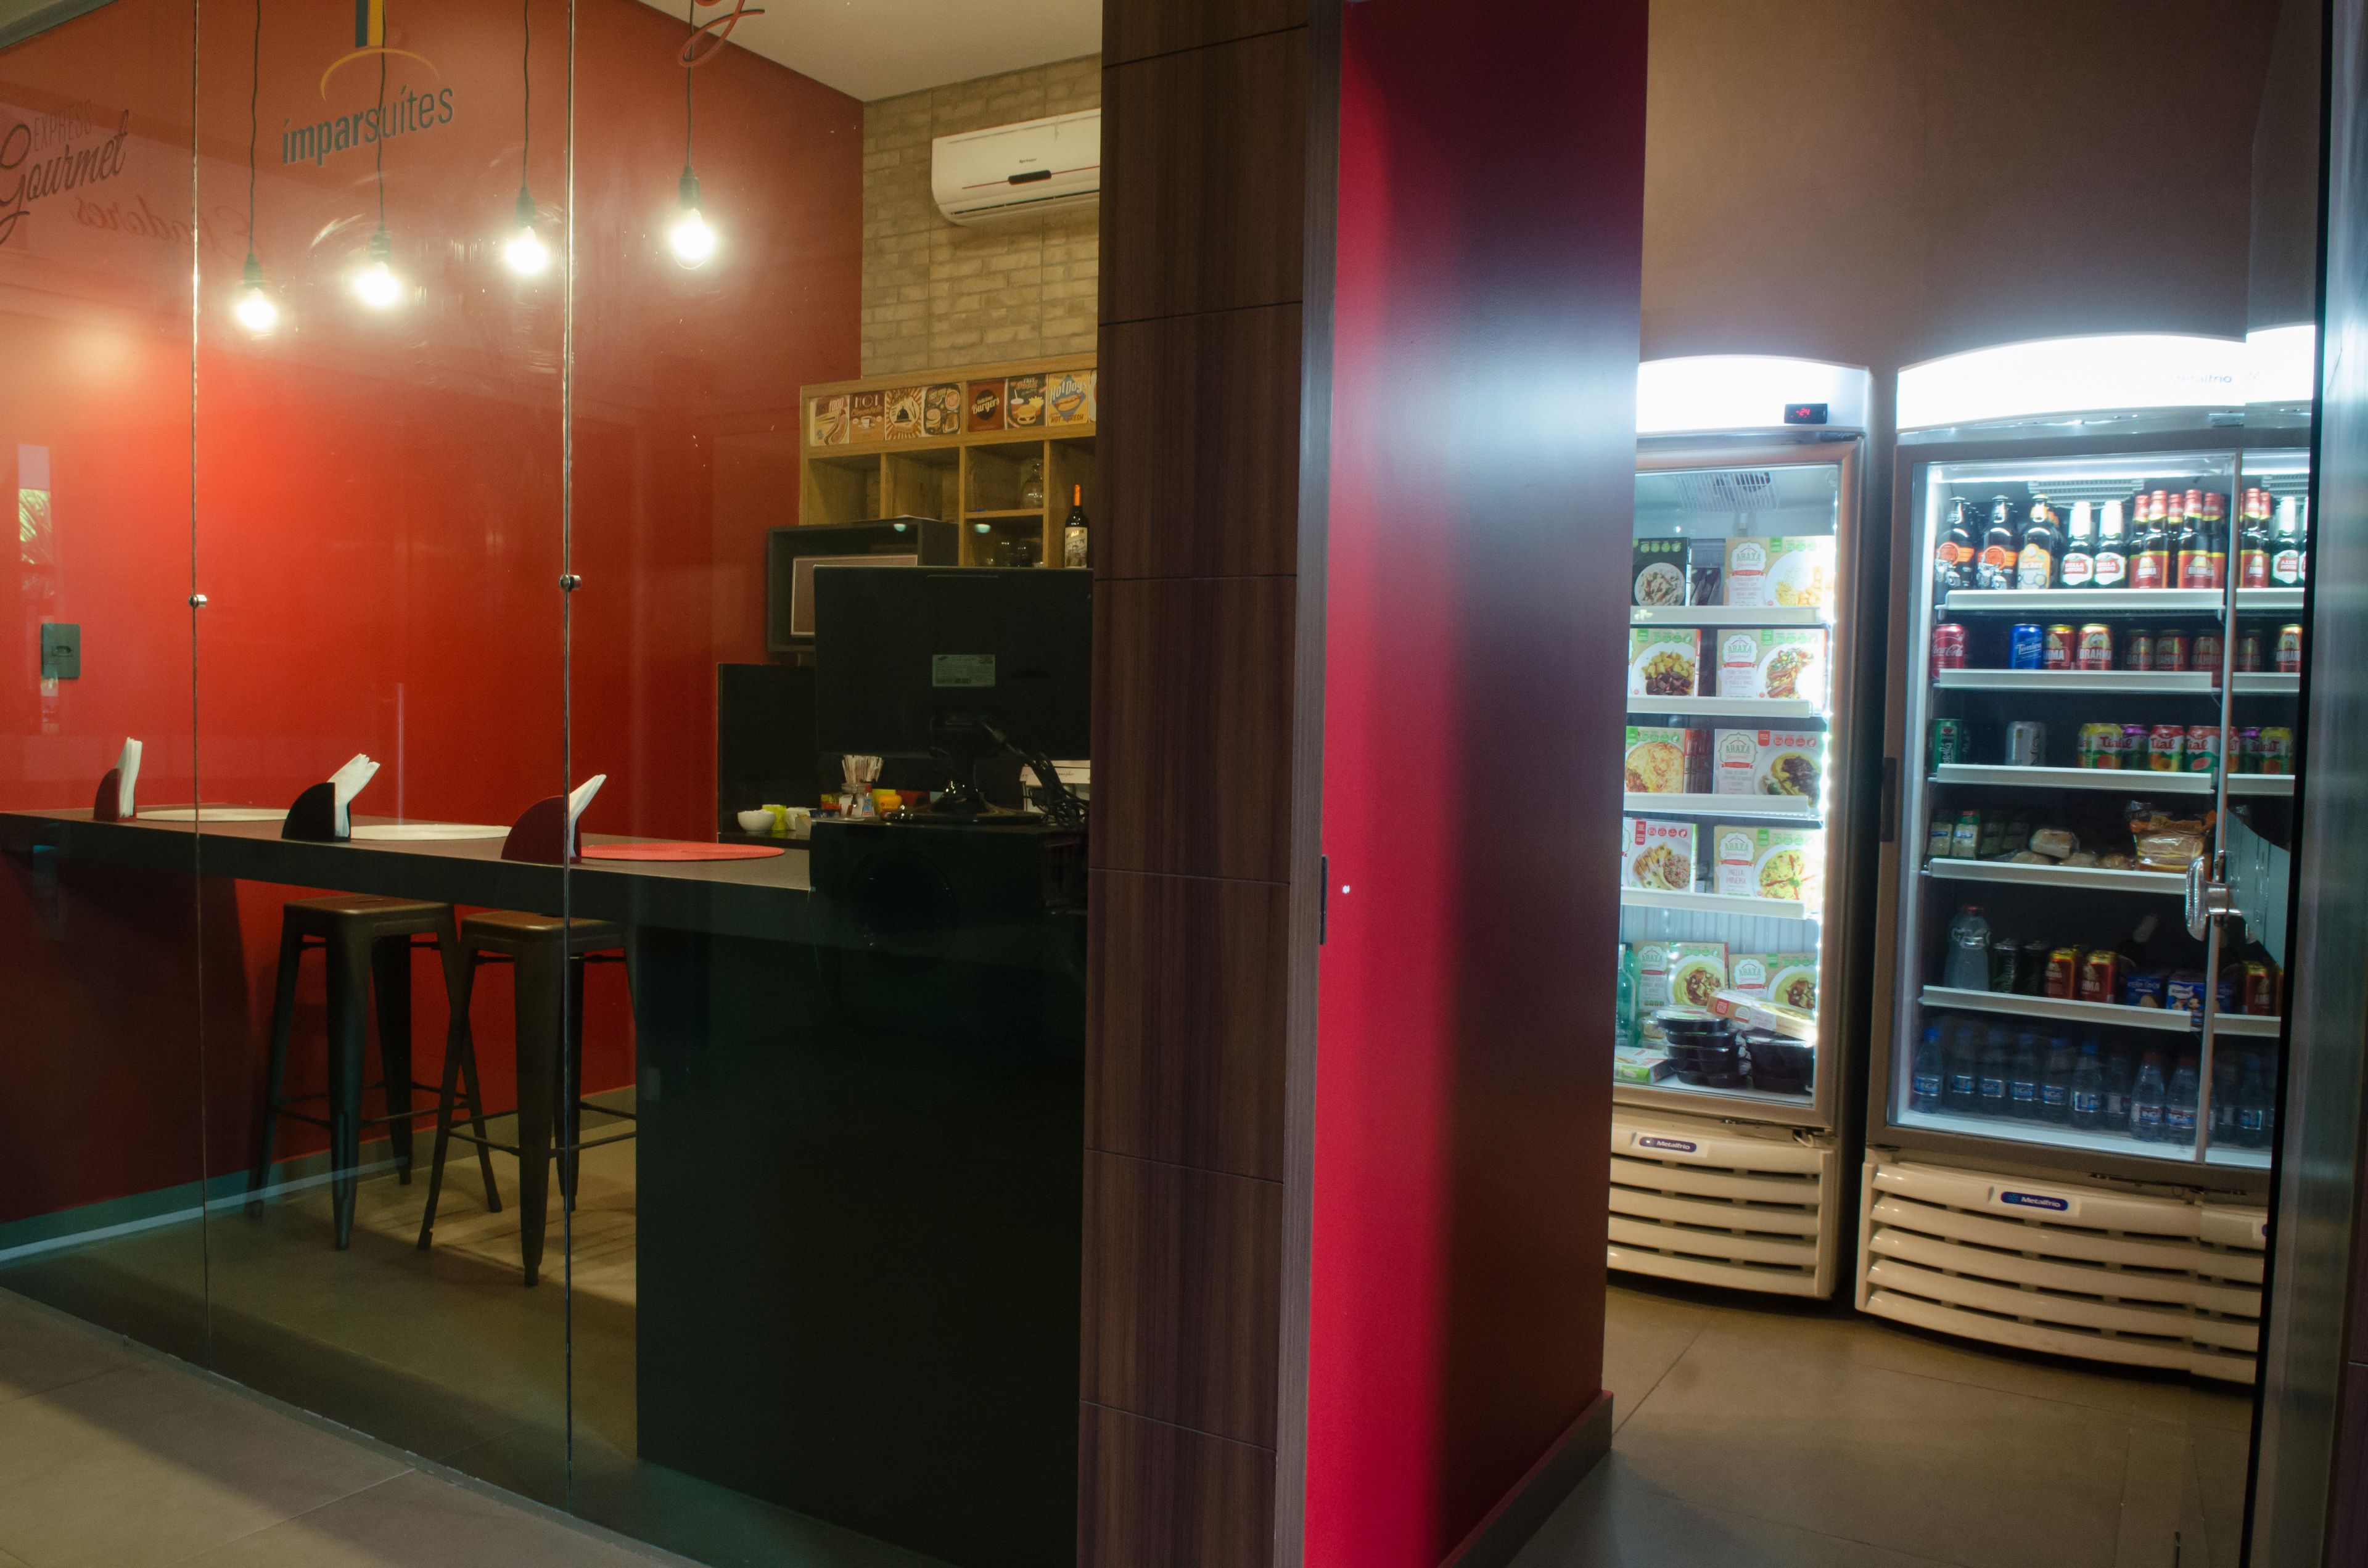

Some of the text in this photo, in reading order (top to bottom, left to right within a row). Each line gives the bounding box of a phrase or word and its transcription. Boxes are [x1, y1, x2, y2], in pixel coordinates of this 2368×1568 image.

[971, 398, 1000, 414] Burgers
[2151, 738, 2174, 749] Tial
[1656, 1140, 1691, 1150] Metalfrio
[2021, 1196, 2062, 1208] Metalfrio
